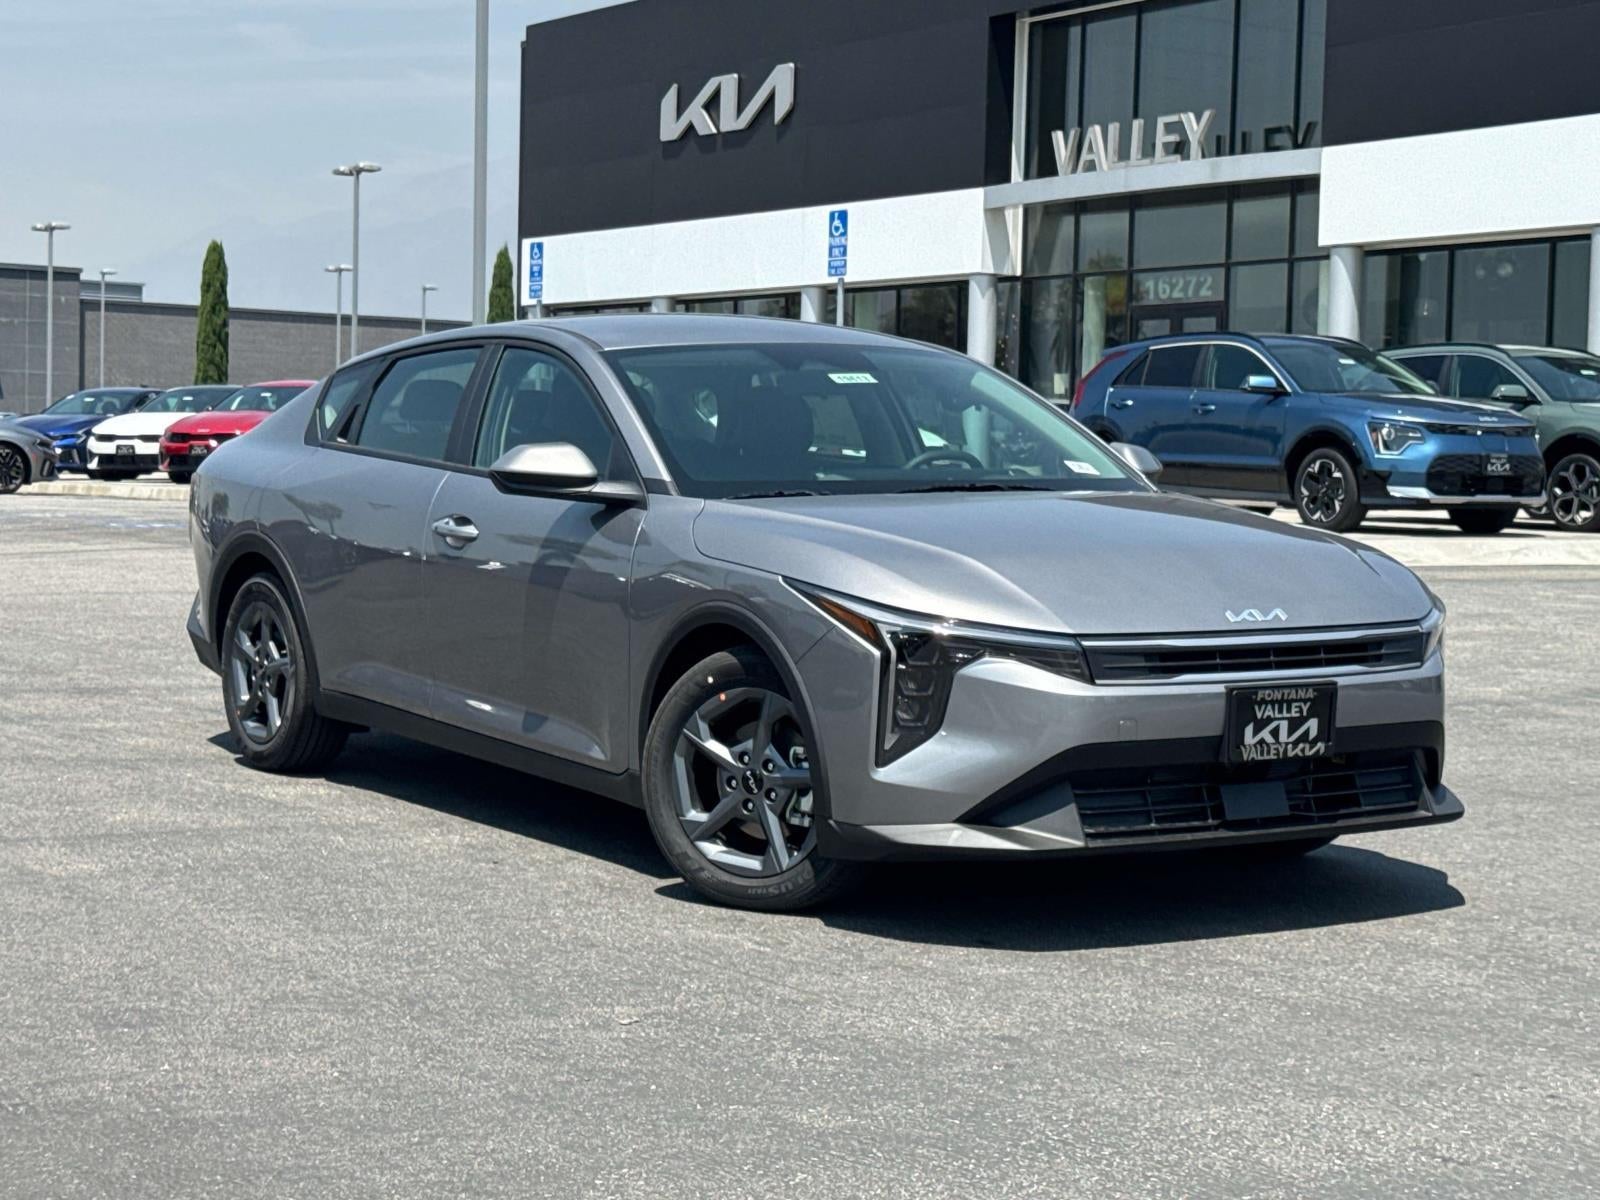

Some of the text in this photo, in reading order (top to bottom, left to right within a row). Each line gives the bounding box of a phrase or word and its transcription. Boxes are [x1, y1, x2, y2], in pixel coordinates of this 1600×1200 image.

[660, 62, 796, 143] KIA
[1051, 109, 1216, 176] VALLEY
[1145, 275, 1213, 300] 16272
[1225, 608, 1288, 622] KIA
[1257, 688, 1315, 701] FONTANA
[1254, 702, 1312, 719] VALLEY
[1244, 718, 1319, 745] KIA
[1240, 742, 1325, 762] VALLEY KIA
